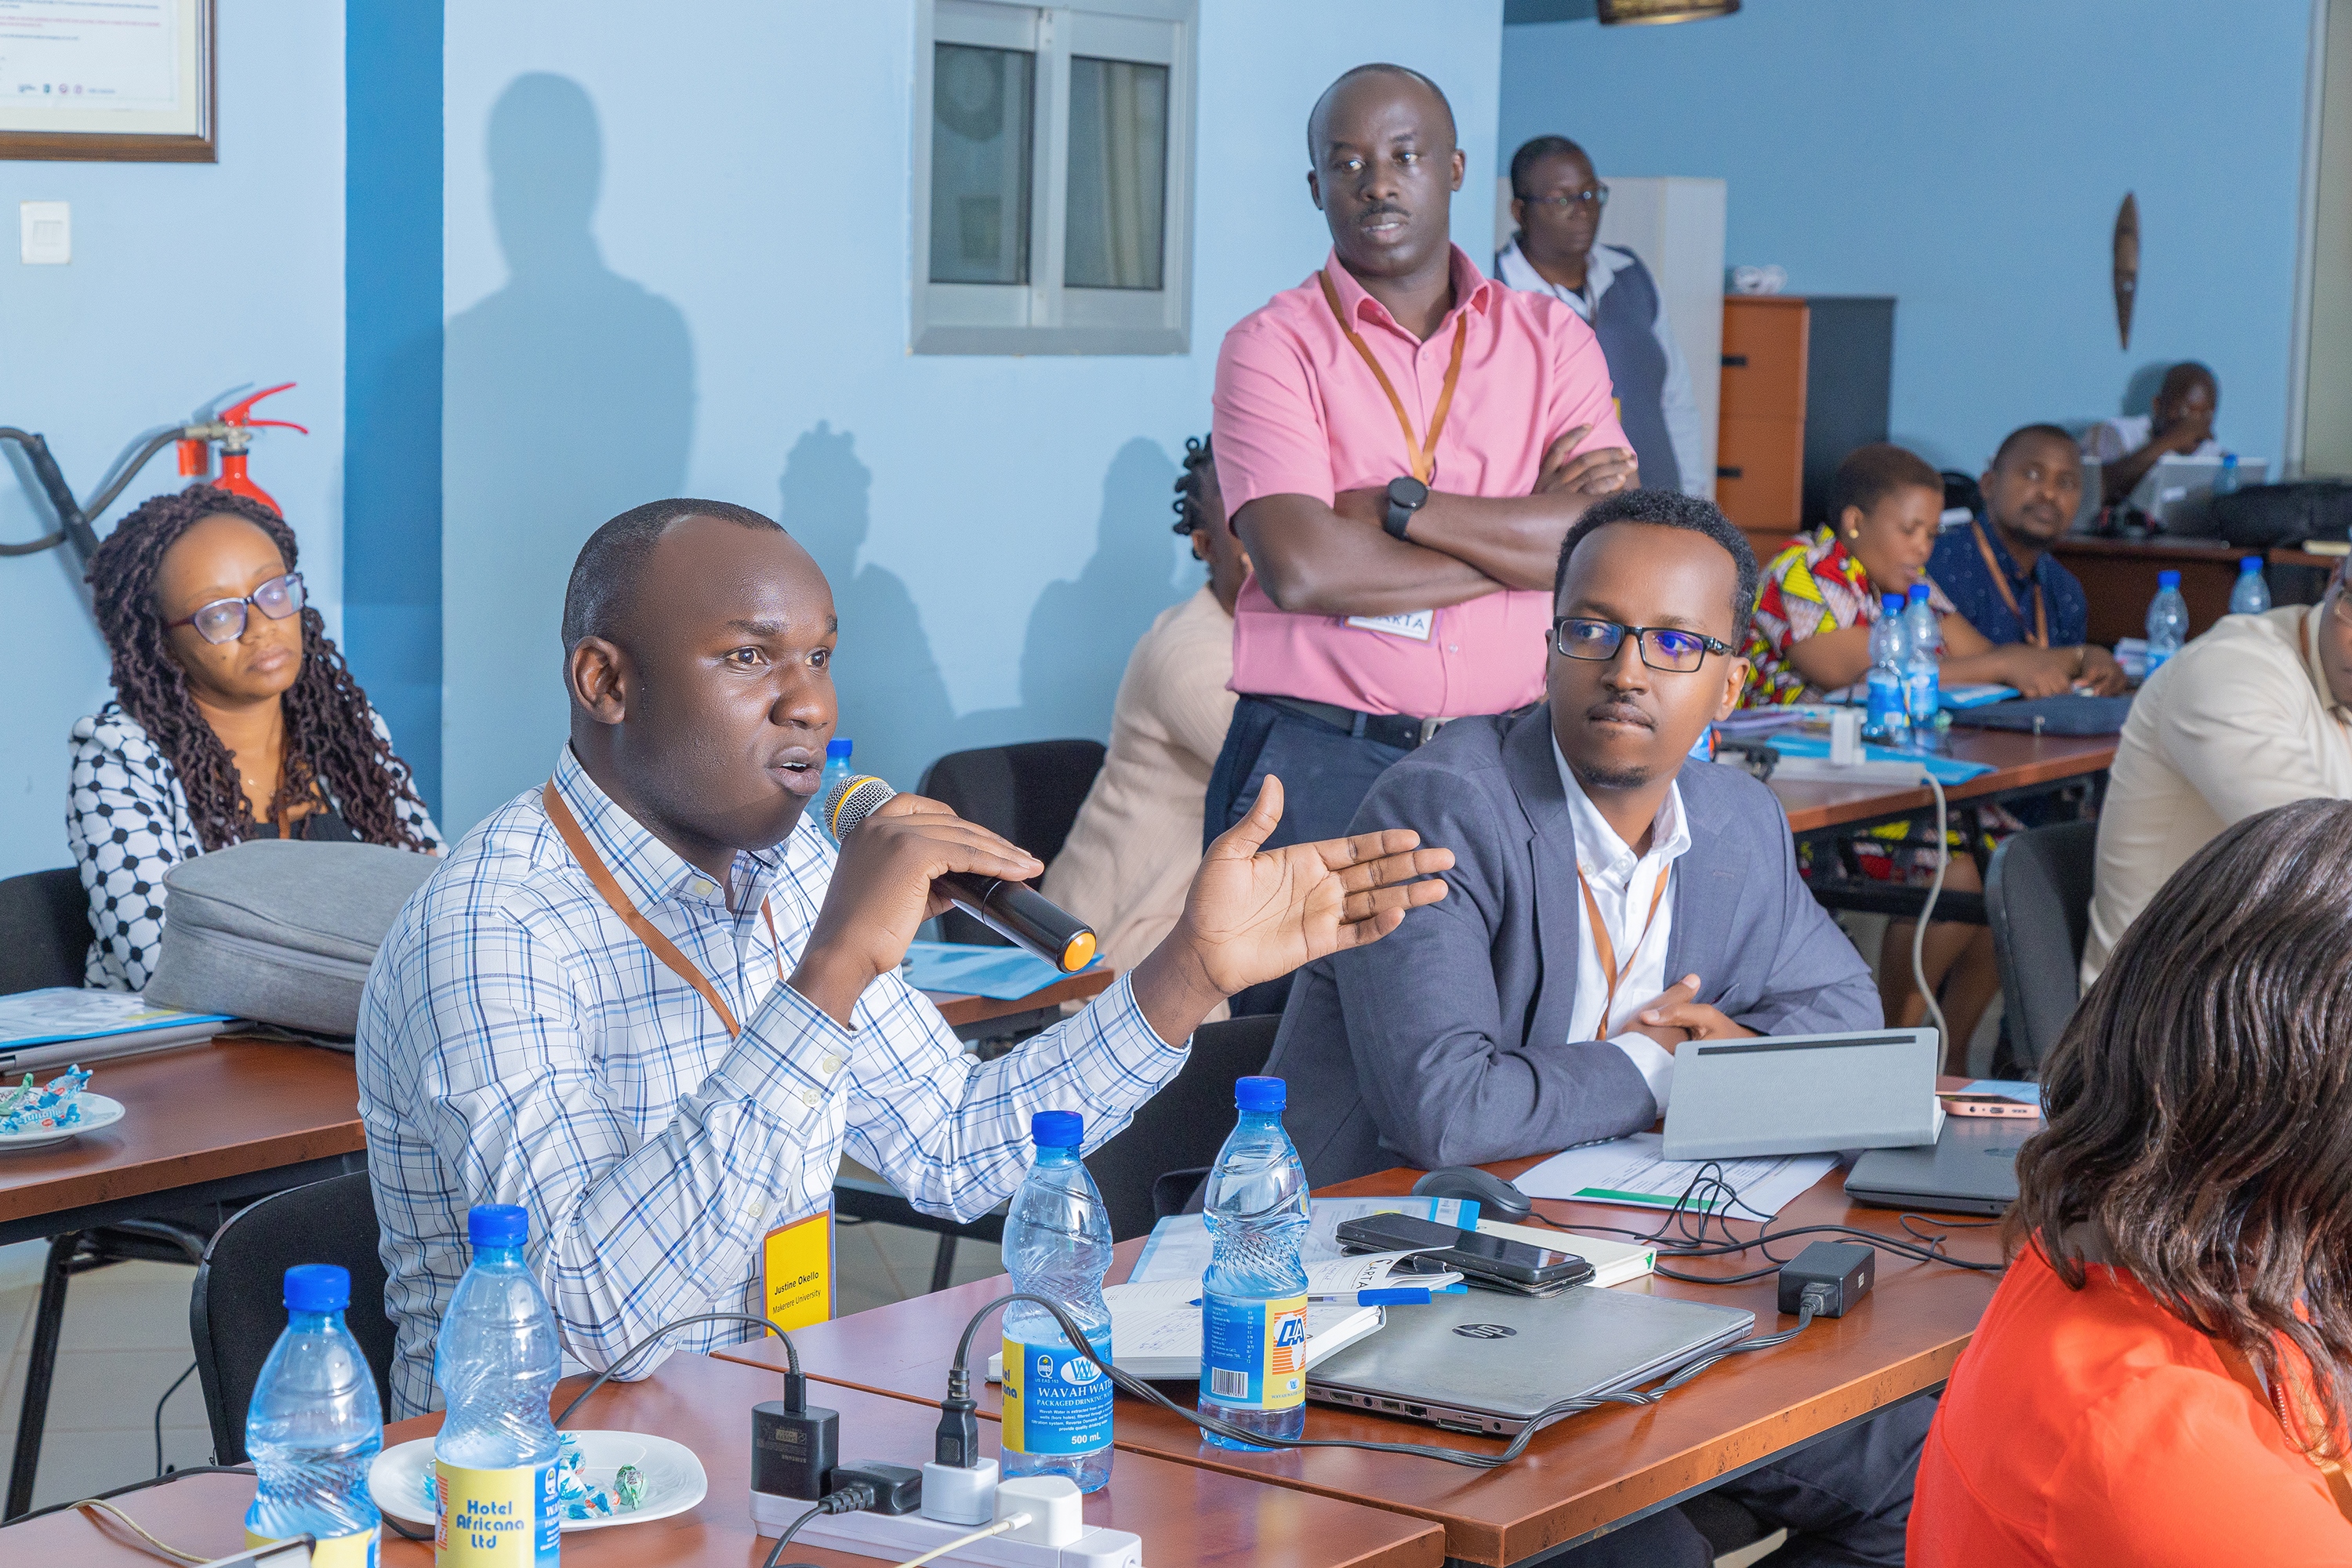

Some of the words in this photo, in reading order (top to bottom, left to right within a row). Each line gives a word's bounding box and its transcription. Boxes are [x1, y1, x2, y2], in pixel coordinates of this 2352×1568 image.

[1356, 1259, 1393, 1289] CARTA
[775, 1280, 797, 1296] Justine
[798, 1271, 819, 1285] Okello
[772, 1299, 795, 1315] Makerere
[795, 1289, 822, 1305] University
[1456, 1325, 1508, 1338] hp
[1038, 1386, 1087, 1398] WAVAH
[1075, 1394, 1103, 1406] DRINKING
[1071, 1435, 1087, 1445] 500
[1090, 1432, 1101, 1442] mL
[466, 1499, 513, 1515] Hotel
[456, 1514, 524, 1531] Africana
[471, 1534, 497, 1549] Ltd
